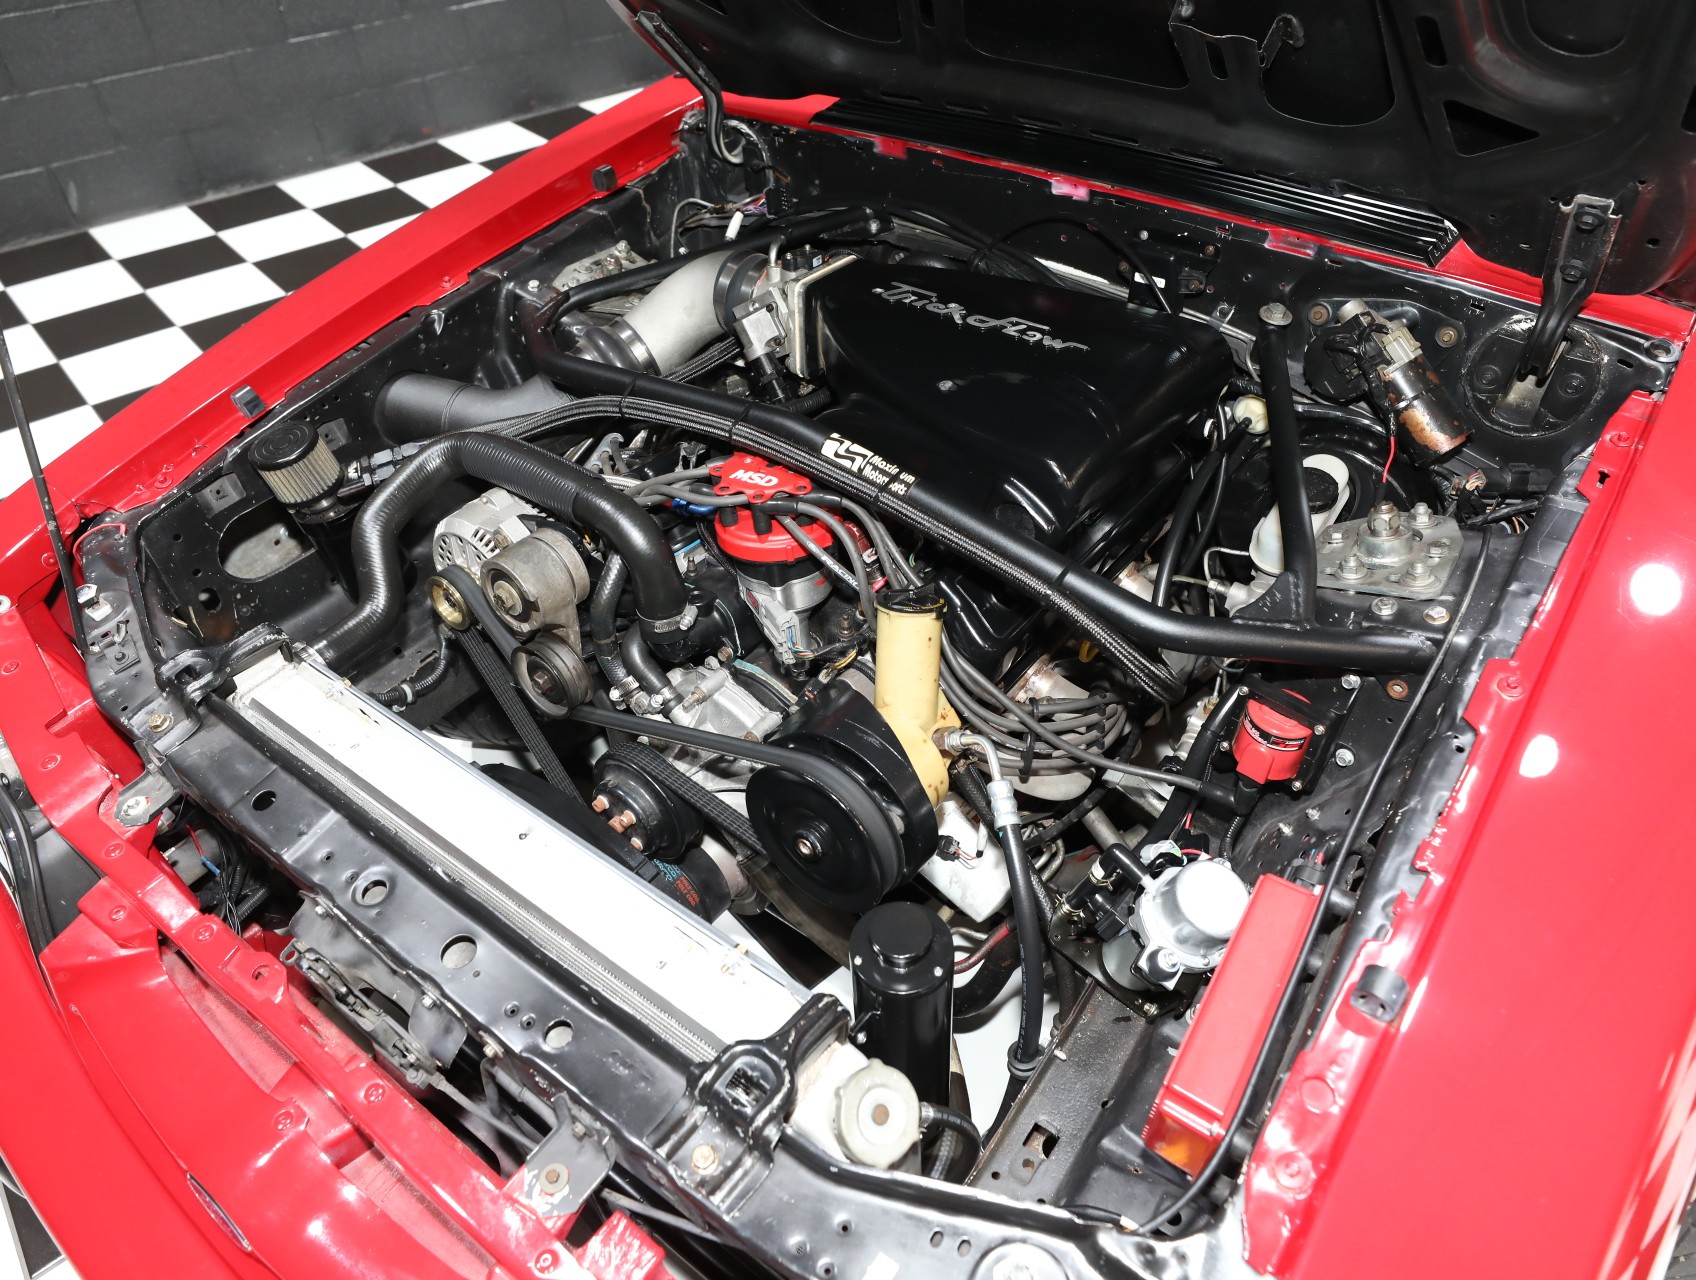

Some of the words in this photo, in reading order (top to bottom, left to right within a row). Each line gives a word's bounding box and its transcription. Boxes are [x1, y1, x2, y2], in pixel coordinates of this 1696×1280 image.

[872, 281, 967, 325] Trick
[966, 314, 1091, 352] Flow
[729, 469, 779, 487] MSD
[862, 463, 908, 496] Motorsorts
